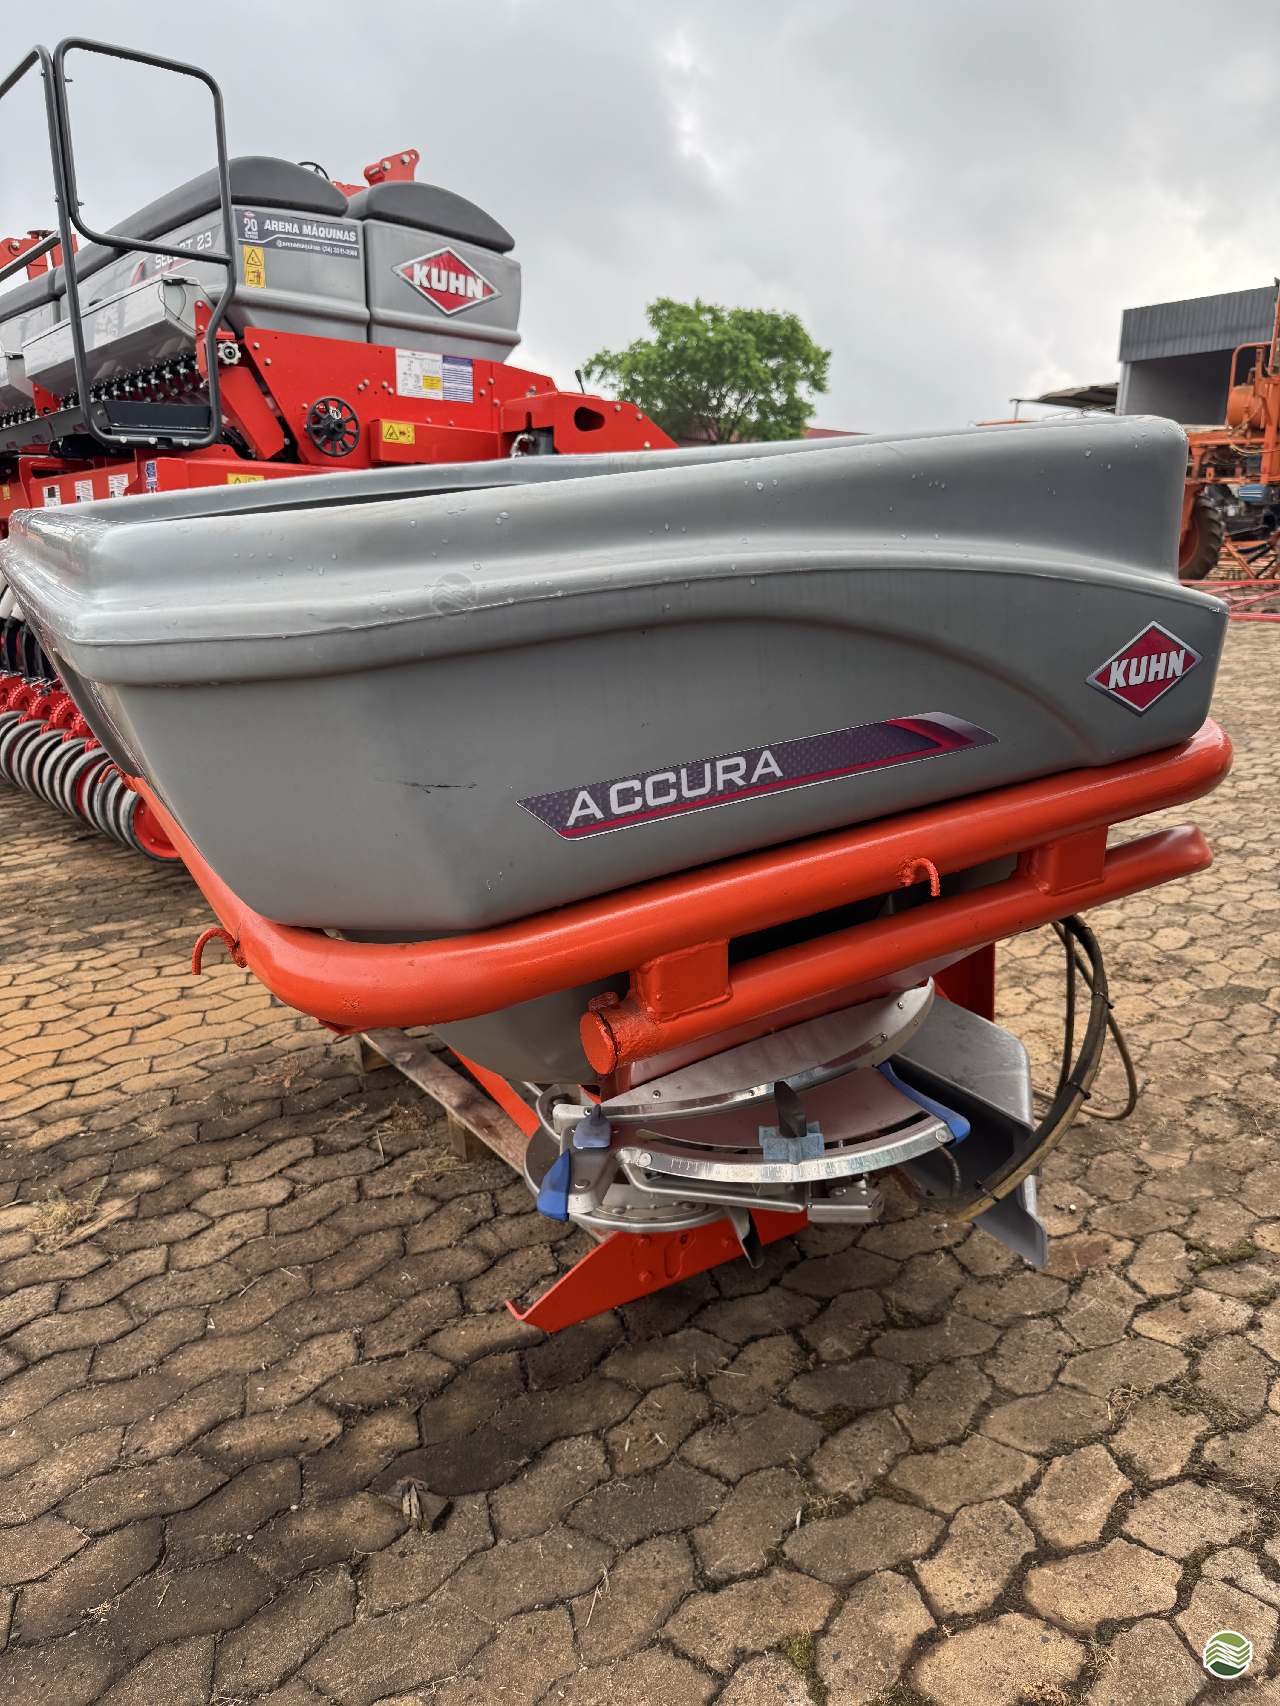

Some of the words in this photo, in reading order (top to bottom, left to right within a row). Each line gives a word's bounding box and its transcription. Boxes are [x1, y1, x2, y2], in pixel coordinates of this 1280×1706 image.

[243, 218, 258, 232] 20
[264, 220, 300, 234] ARENA
[302, 224, 357, 242] MÁQUINAS
[197, 231, 212, 251] 23
[412, 263, 484, 300] KUHN
[1108, 648, 1186, 690] KUHN
[565, 749, 784, 827] ACCURA
